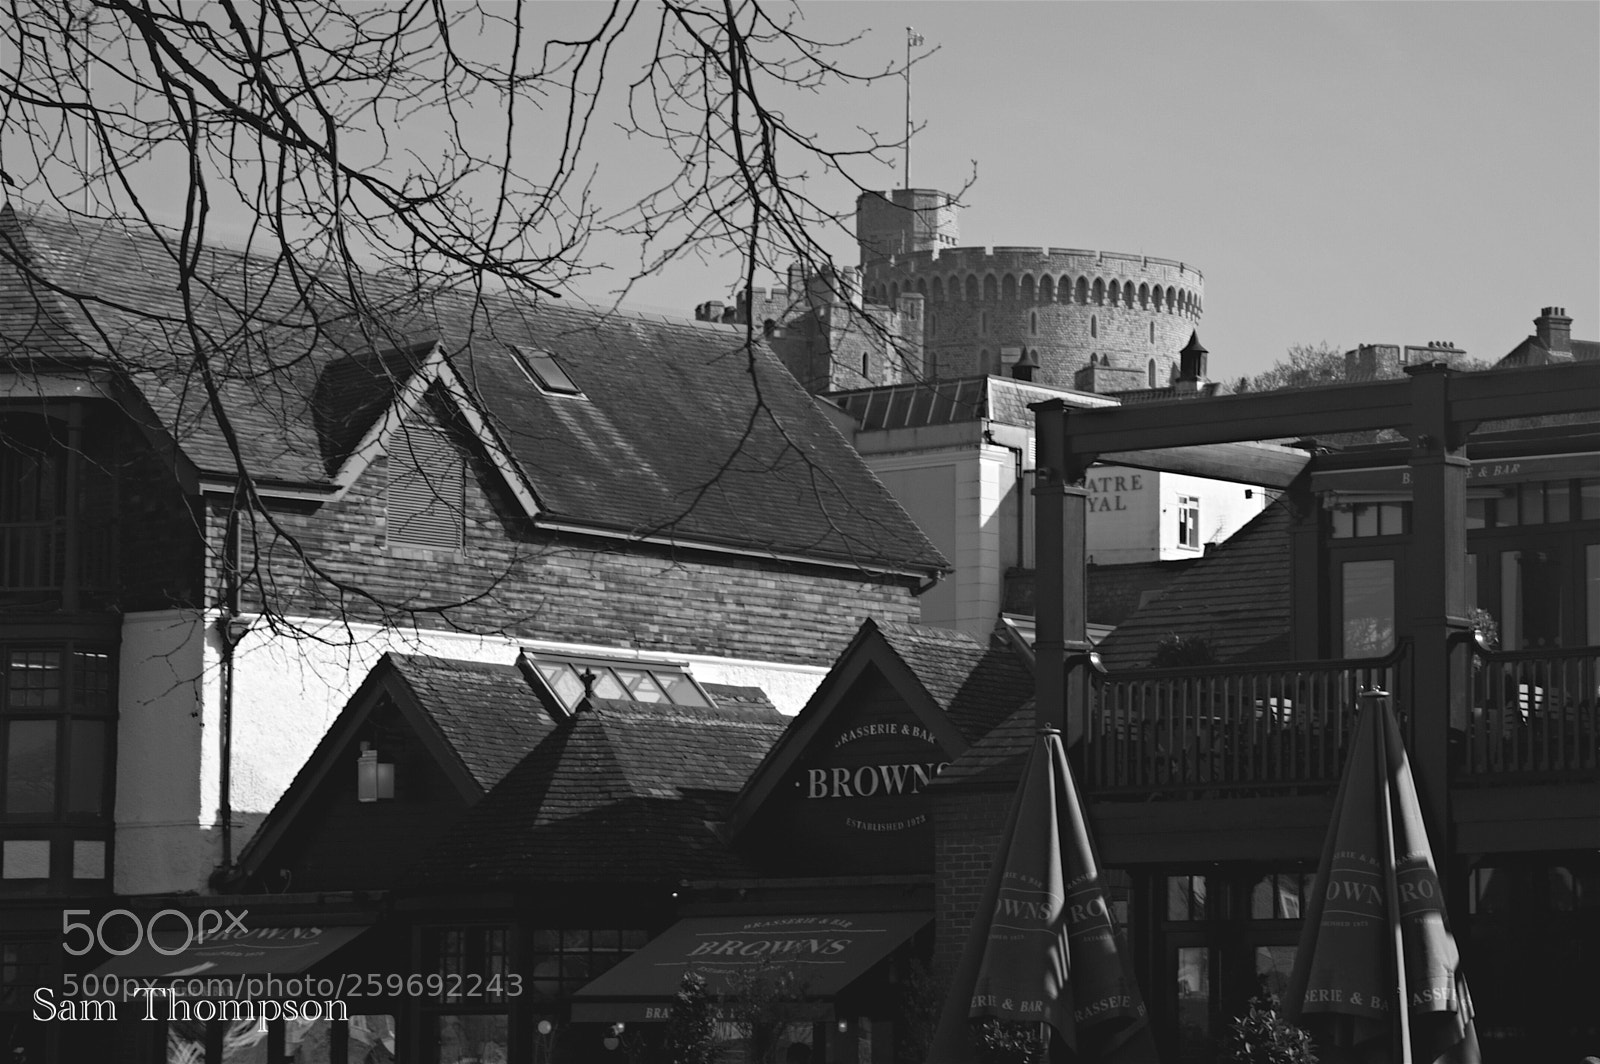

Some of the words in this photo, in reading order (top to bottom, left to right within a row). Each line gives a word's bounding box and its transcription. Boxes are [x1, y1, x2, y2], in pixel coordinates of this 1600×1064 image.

[901, 724, 911, 736] &
[846, 817, 904, 832] ESTABLISHED
[686, 939, 853, 957] BROWNS
[1002, 998, 1014, 1011] &
[1020, 1000, 1044, 1013] BAR
[1350, 992, 1363, 1006] &
[645, 1007, 672, 1019] BRA
